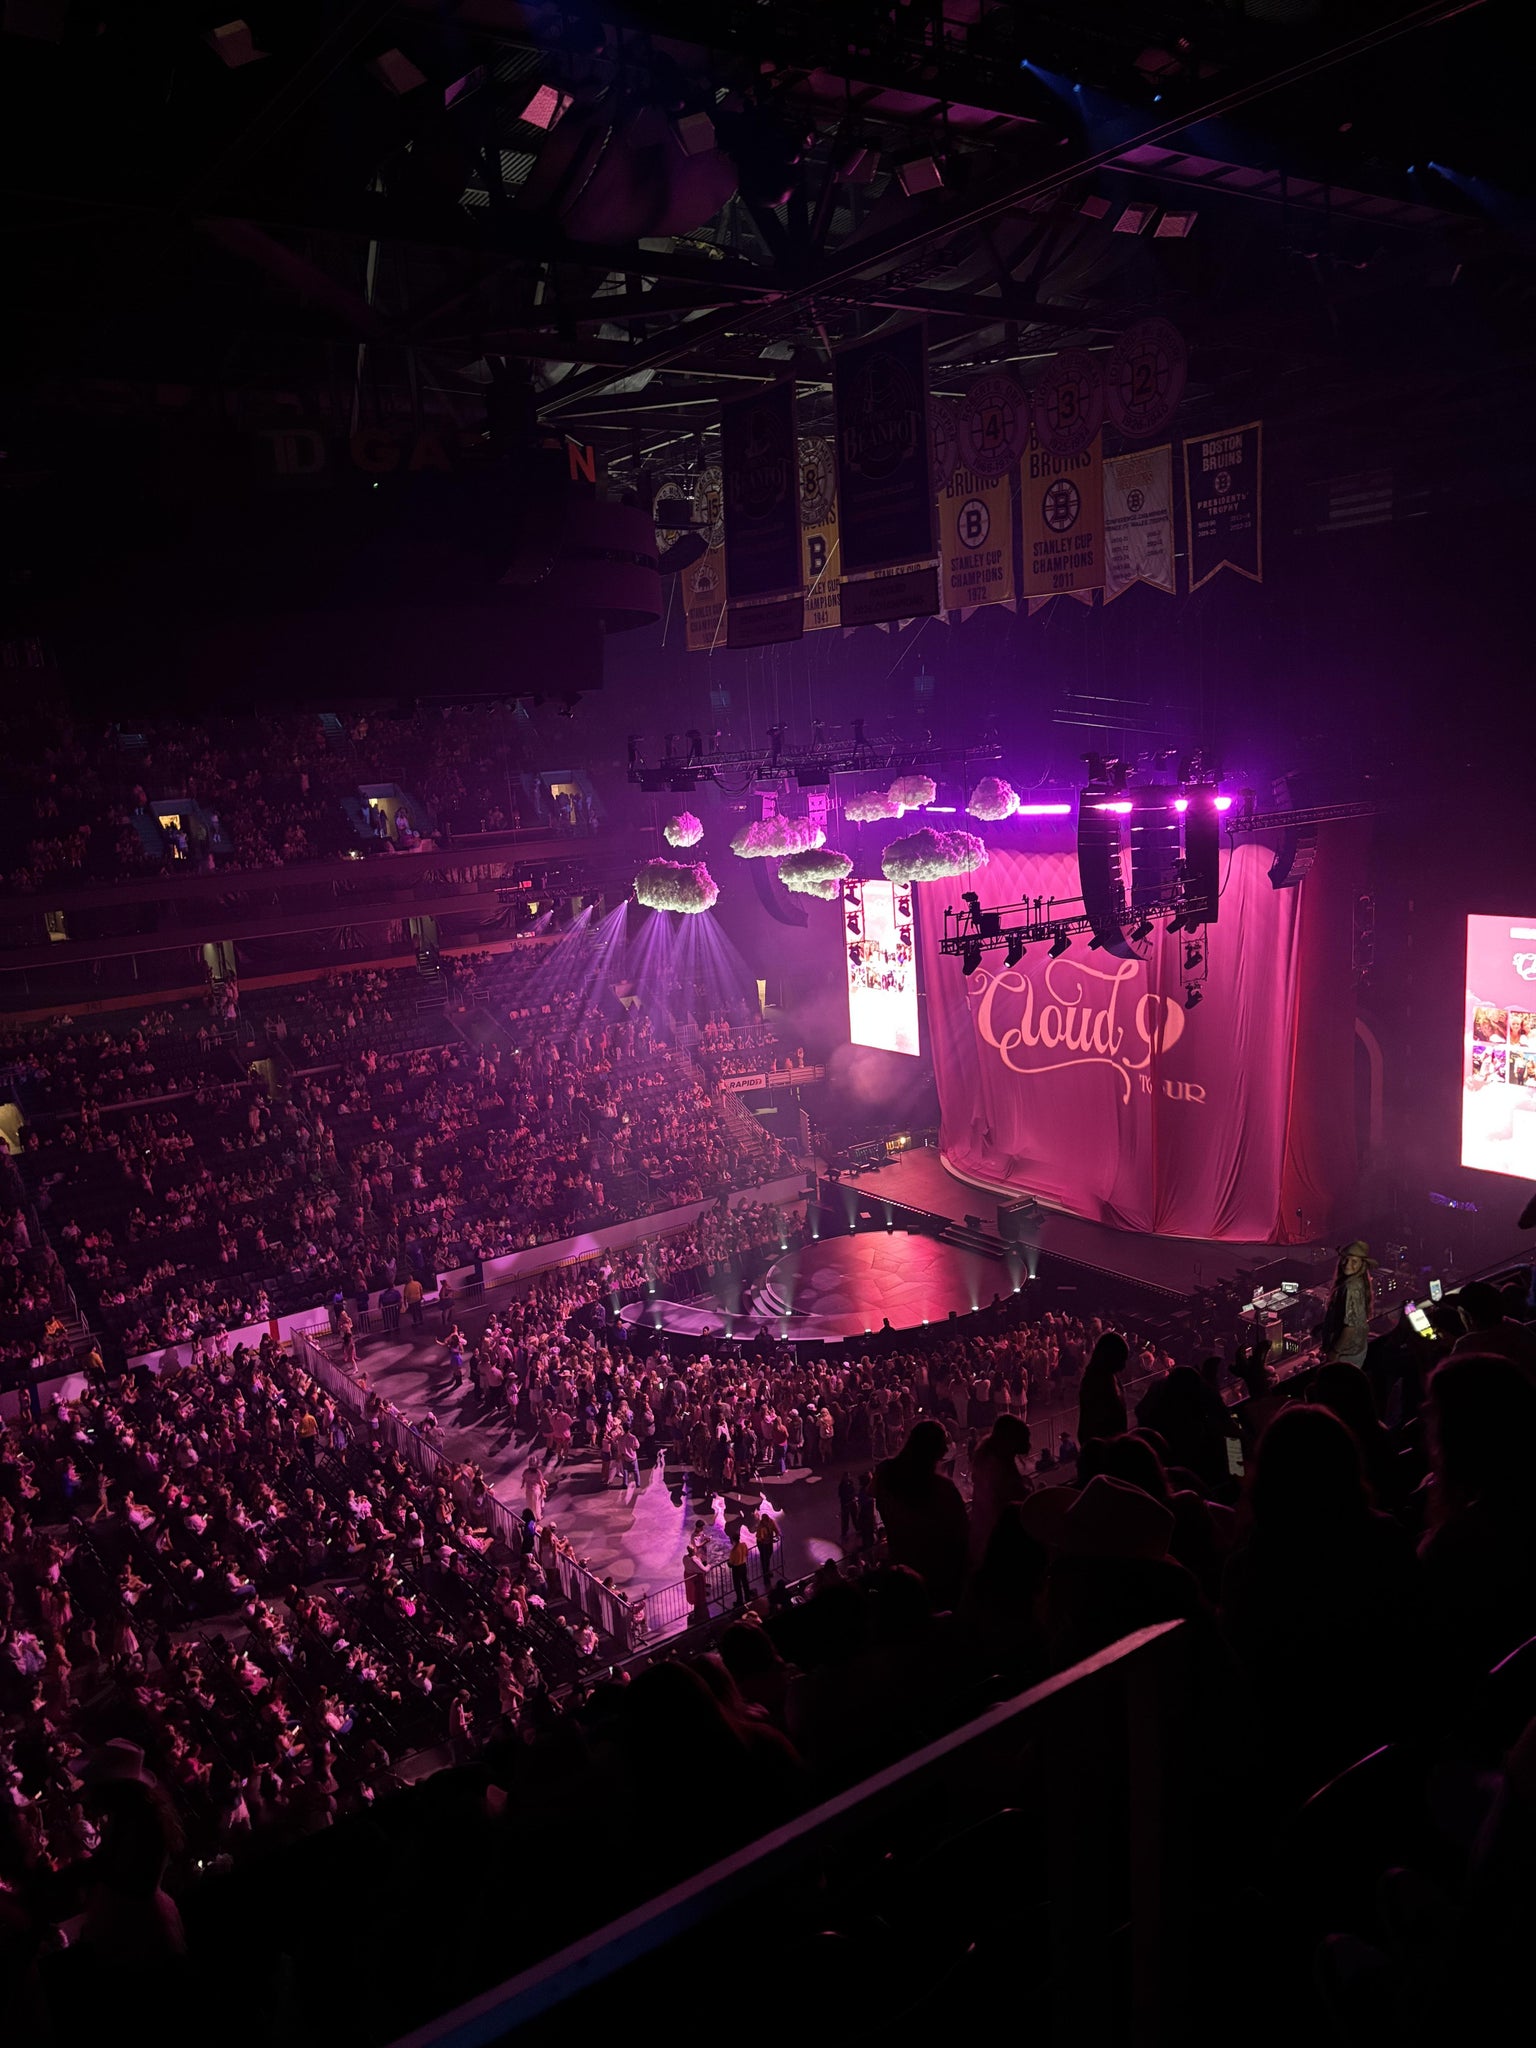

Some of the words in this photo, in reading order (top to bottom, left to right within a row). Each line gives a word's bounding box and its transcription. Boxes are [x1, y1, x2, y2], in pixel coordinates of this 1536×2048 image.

[1136, 364, 1152, 395] 2
[1062, 390, 1075, 419] 3
[986, 414, 1000, 440] 4
[1202, 434, 1243, 458] BOSTON
[1202, 450, 1243, 473] BRUINS
[806, 468, 816, 495] 8
[1208, 503, 1240, 517] TROPHY
[966, 509, 981, 539] B
[808, 535, 827, 577] B
[1033, 537, 1072, 557] STANLEY
[1074, 533, 1093, 551] CUP
[951, 553, 983, 572] STANLEY
[985, 551, 1002, 567] CUP
[1032, 552, 1094, 574] CHAMPIONS
[951, 566, 1003, 589] CHAMPIONS
[1053, 573, 1074, 589] 2011
[804, 594, 841, 611] HAMPIONS
[967, 959, 1139, 1100] Cloud
[1123, 994, 1185, 1069] 9
